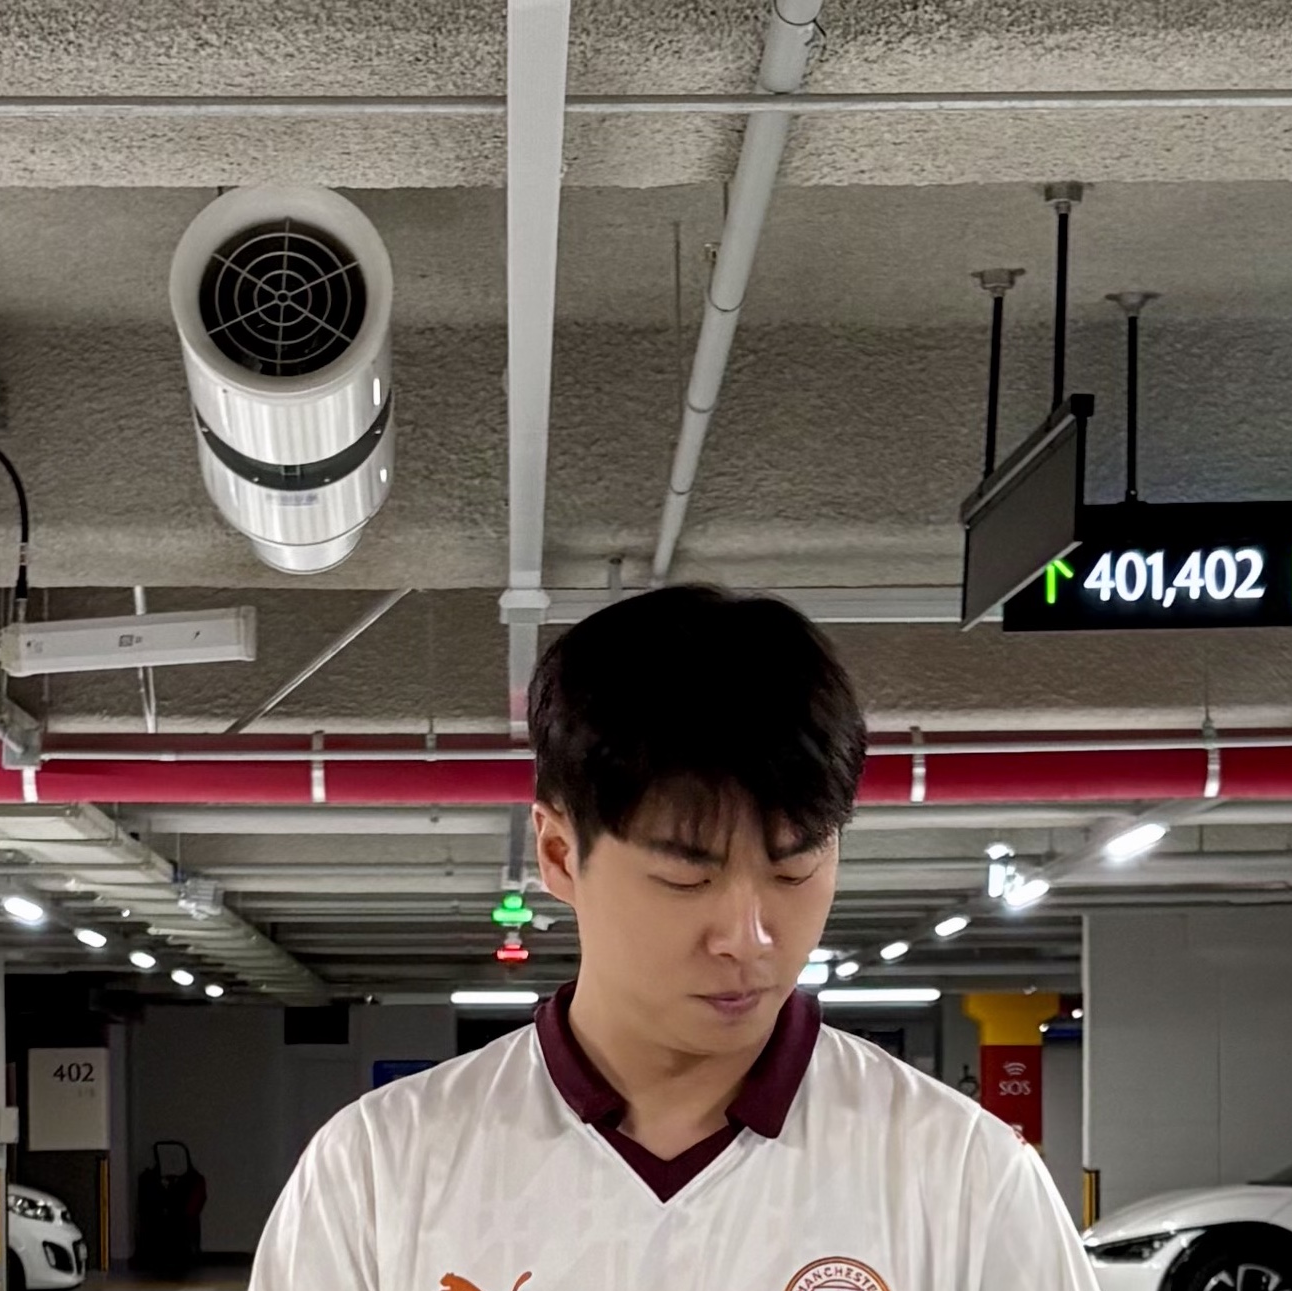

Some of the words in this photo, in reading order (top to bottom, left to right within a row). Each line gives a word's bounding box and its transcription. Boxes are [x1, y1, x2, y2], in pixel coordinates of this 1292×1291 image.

[1084, 549, 1266, 608] 401,402
[53, 1062, 95, 1082] 402
[998, 1081, 1031, 1096] SOS
